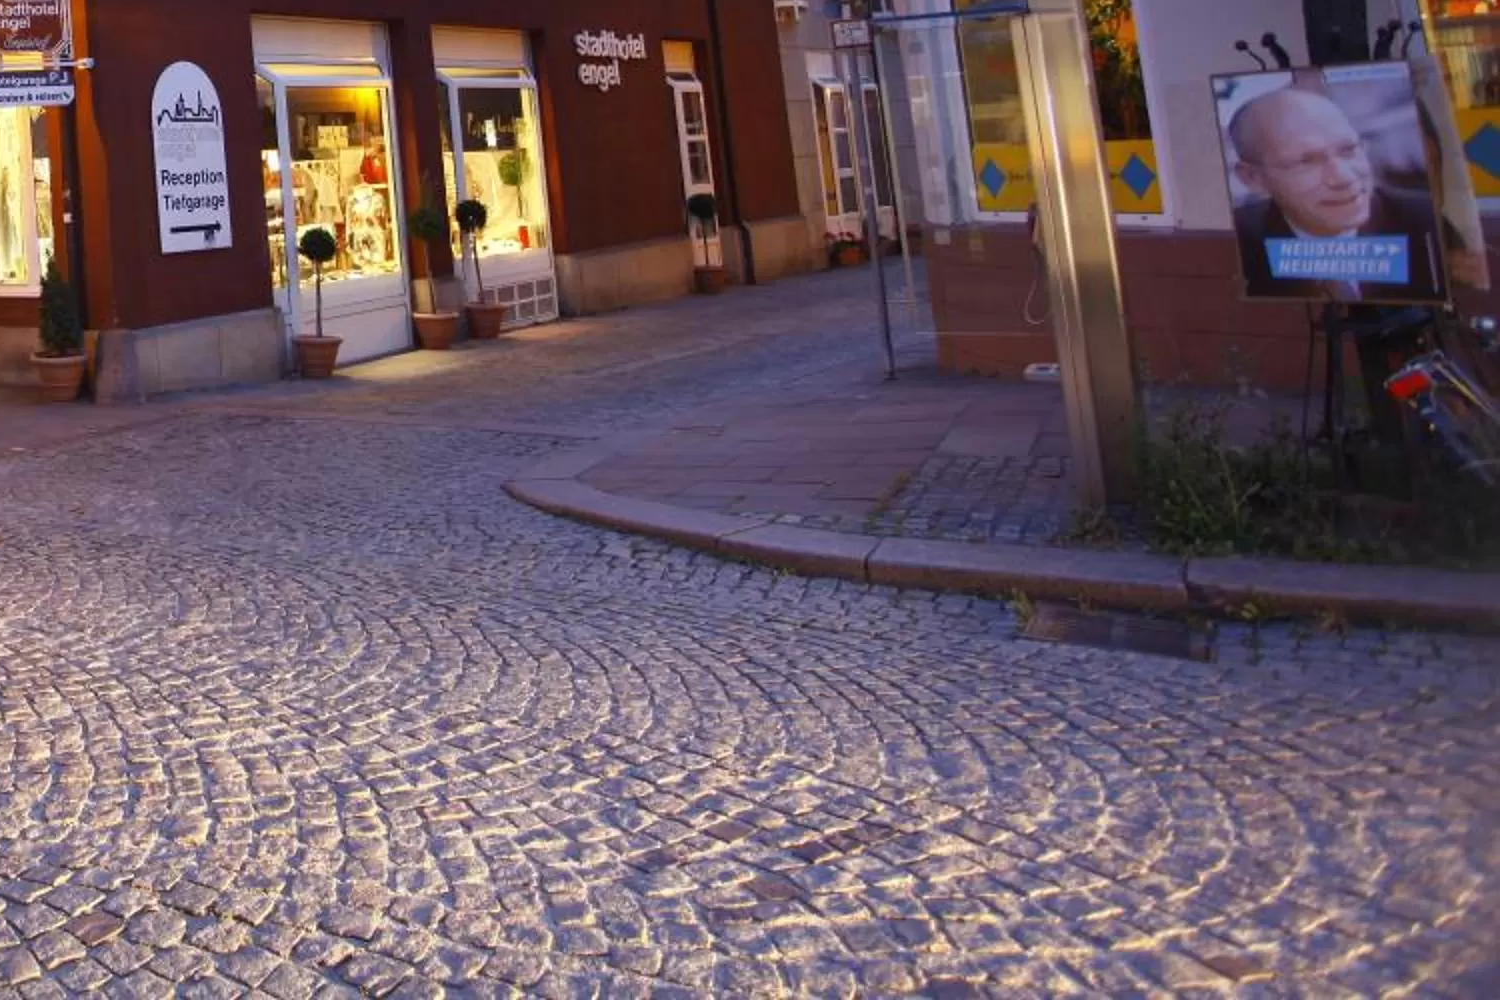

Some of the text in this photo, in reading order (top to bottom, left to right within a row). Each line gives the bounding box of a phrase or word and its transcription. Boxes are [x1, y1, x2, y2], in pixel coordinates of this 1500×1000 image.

[573, 29, 647, 61] stadthotel
[578, 59, 621, 92] engel
[161, 168, 225, 188] Reception
[163, 194, 226, 213] Tiefgarage
[1280, 240, 1368, 257] NEUSTART
[1278, 257, 1393, 276] NEUMEISTER
